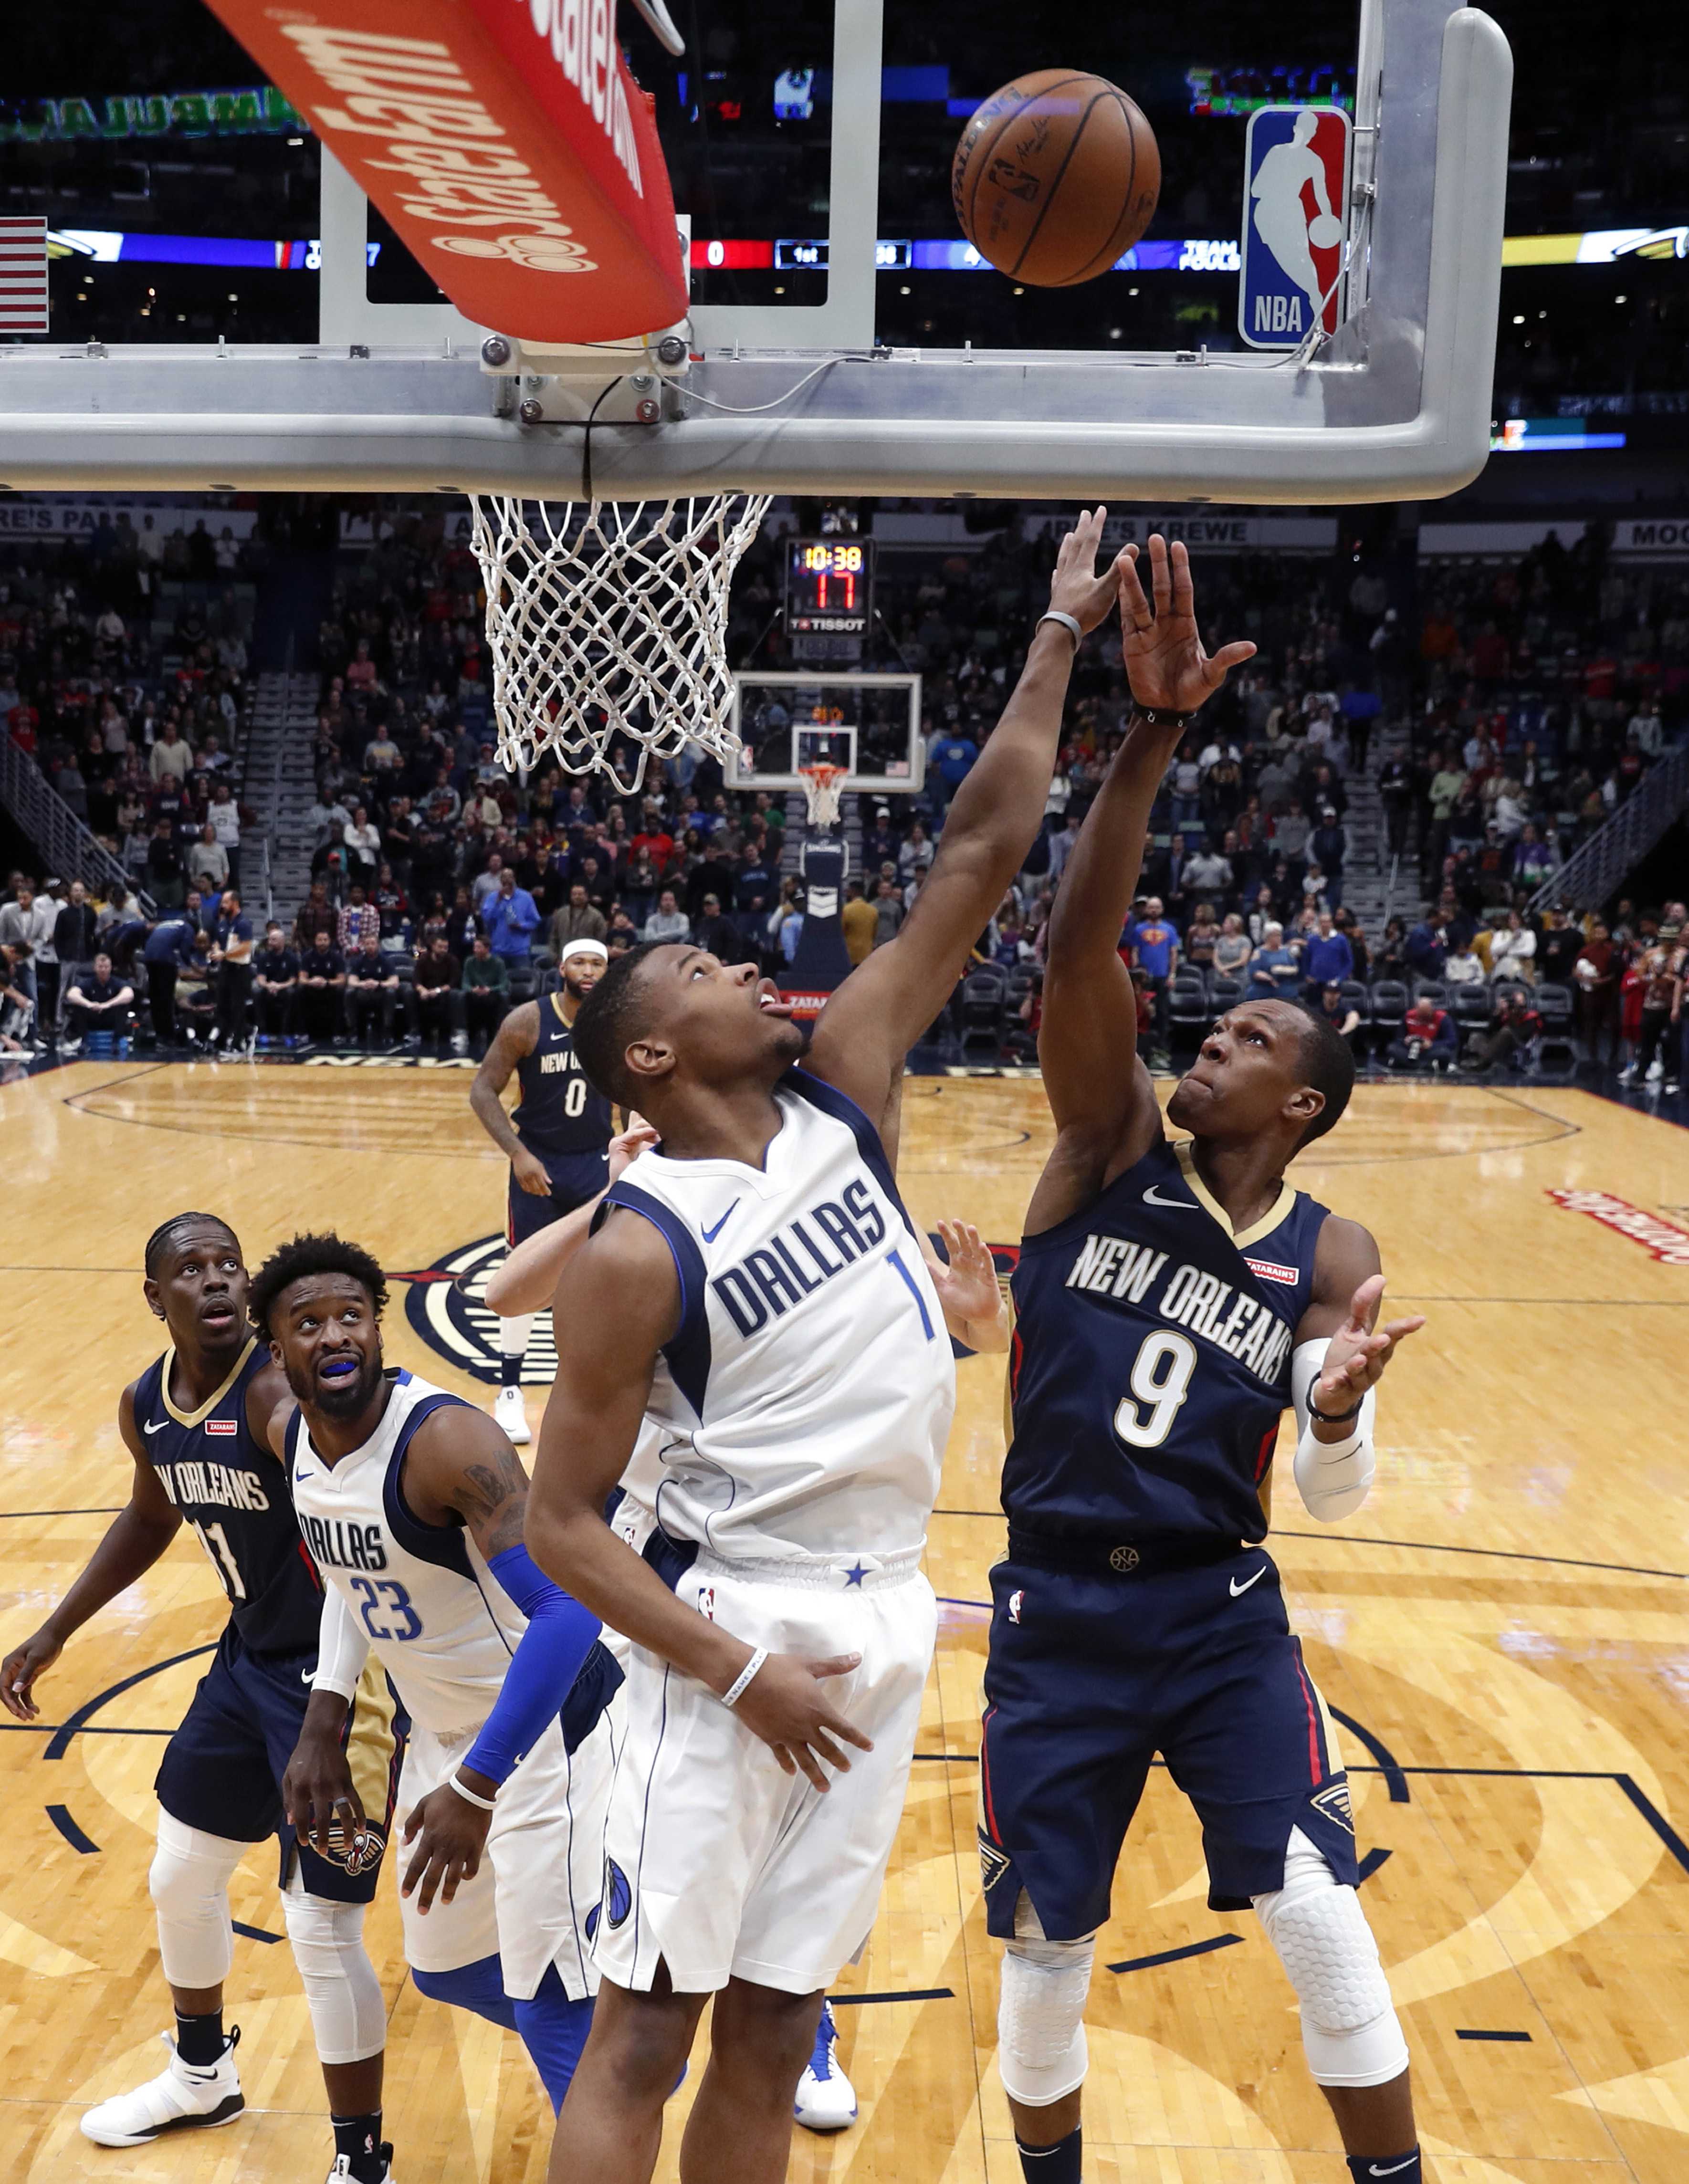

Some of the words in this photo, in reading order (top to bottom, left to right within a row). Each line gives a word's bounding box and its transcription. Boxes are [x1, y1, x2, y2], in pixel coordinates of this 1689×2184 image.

[707, 240, 724, 266] 0
[1179, 253, 1241, 271] FOULS
[1184, 240, 1238, 256] TEAM
[1255, 295, 1302, 332] NBA
[1147, 520, 1248, 541] KREWE
[806, 546, 861, 571] 10:38
[817, 570, 855, 609] 17
[811, 617, 866, 631] TISSOT
[540, 1051, 569, 1075] NEW
[565, 1077, 587, 1118] 0
[708, 1179, 887, 1342] DALLAS
[883, 1249, 937, 1344] 1
[1065, 1233, 1170, 1304] NEW
[1158, 1264, 1293, 1385] ORLEANS
[1113, 1329, 1197, 1448] 9
[174, 1461, 270, 1512] ORLEANS
[350, 1577, 424, 1642] 23
